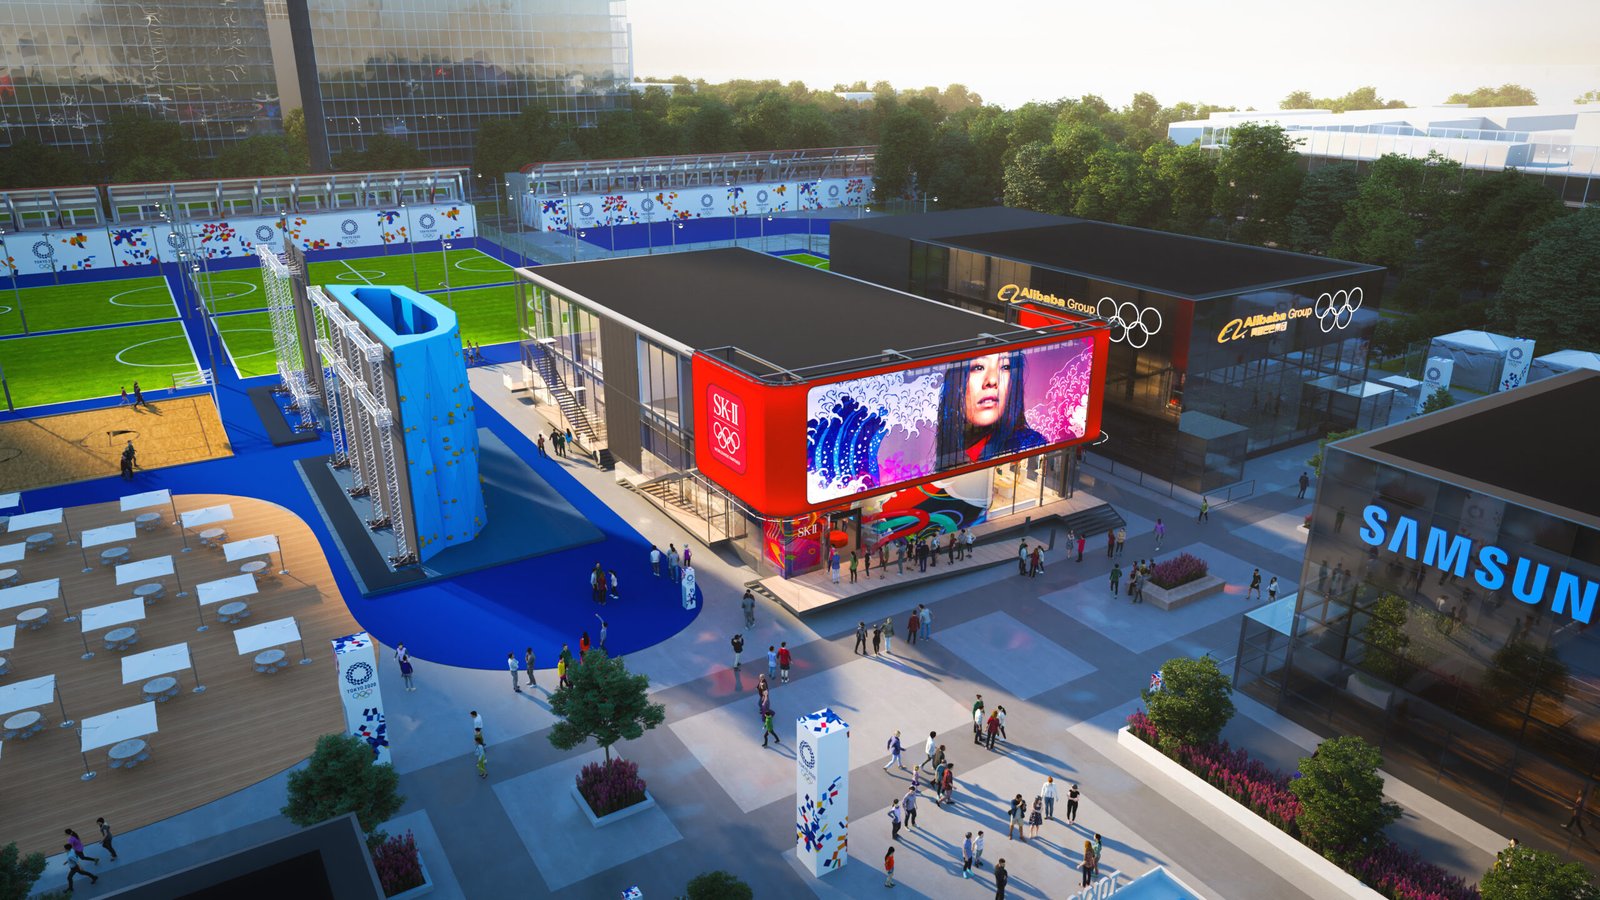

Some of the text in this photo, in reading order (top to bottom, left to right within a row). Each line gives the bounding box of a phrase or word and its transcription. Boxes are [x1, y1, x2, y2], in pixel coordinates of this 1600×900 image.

[1020, 287, 1096, 315] Alibaba Group
[1243, 312, 1287, 329] Alibaba
[1288, 307, 1313, 319] Group
[346, 681, 377, 694] TOKYO 2020
